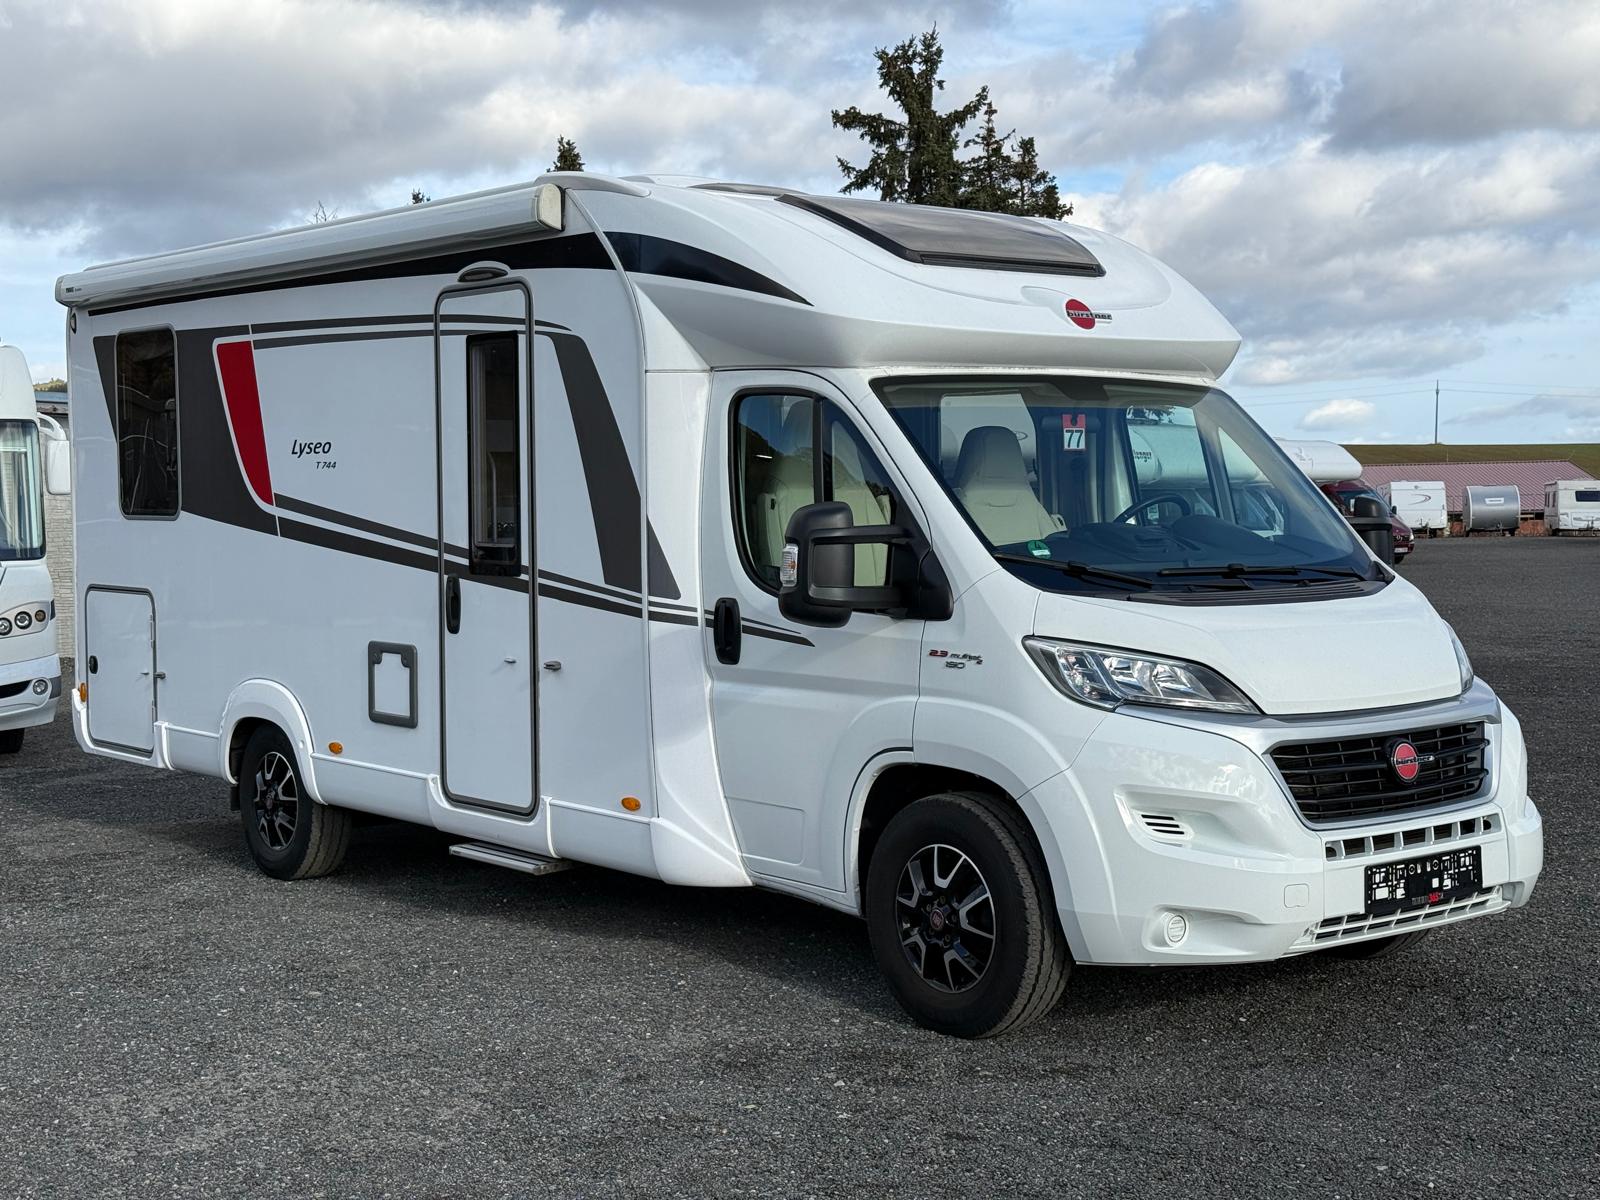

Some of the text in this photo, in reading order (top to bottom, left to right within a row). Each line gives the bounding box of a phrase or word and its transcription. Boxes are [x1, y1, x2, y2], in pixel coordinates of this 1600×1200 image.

[291, 439, 332, 459] Lyseo
[1065, 429, 1084, 449] 77
[316, 461, 337, 470] T 744
